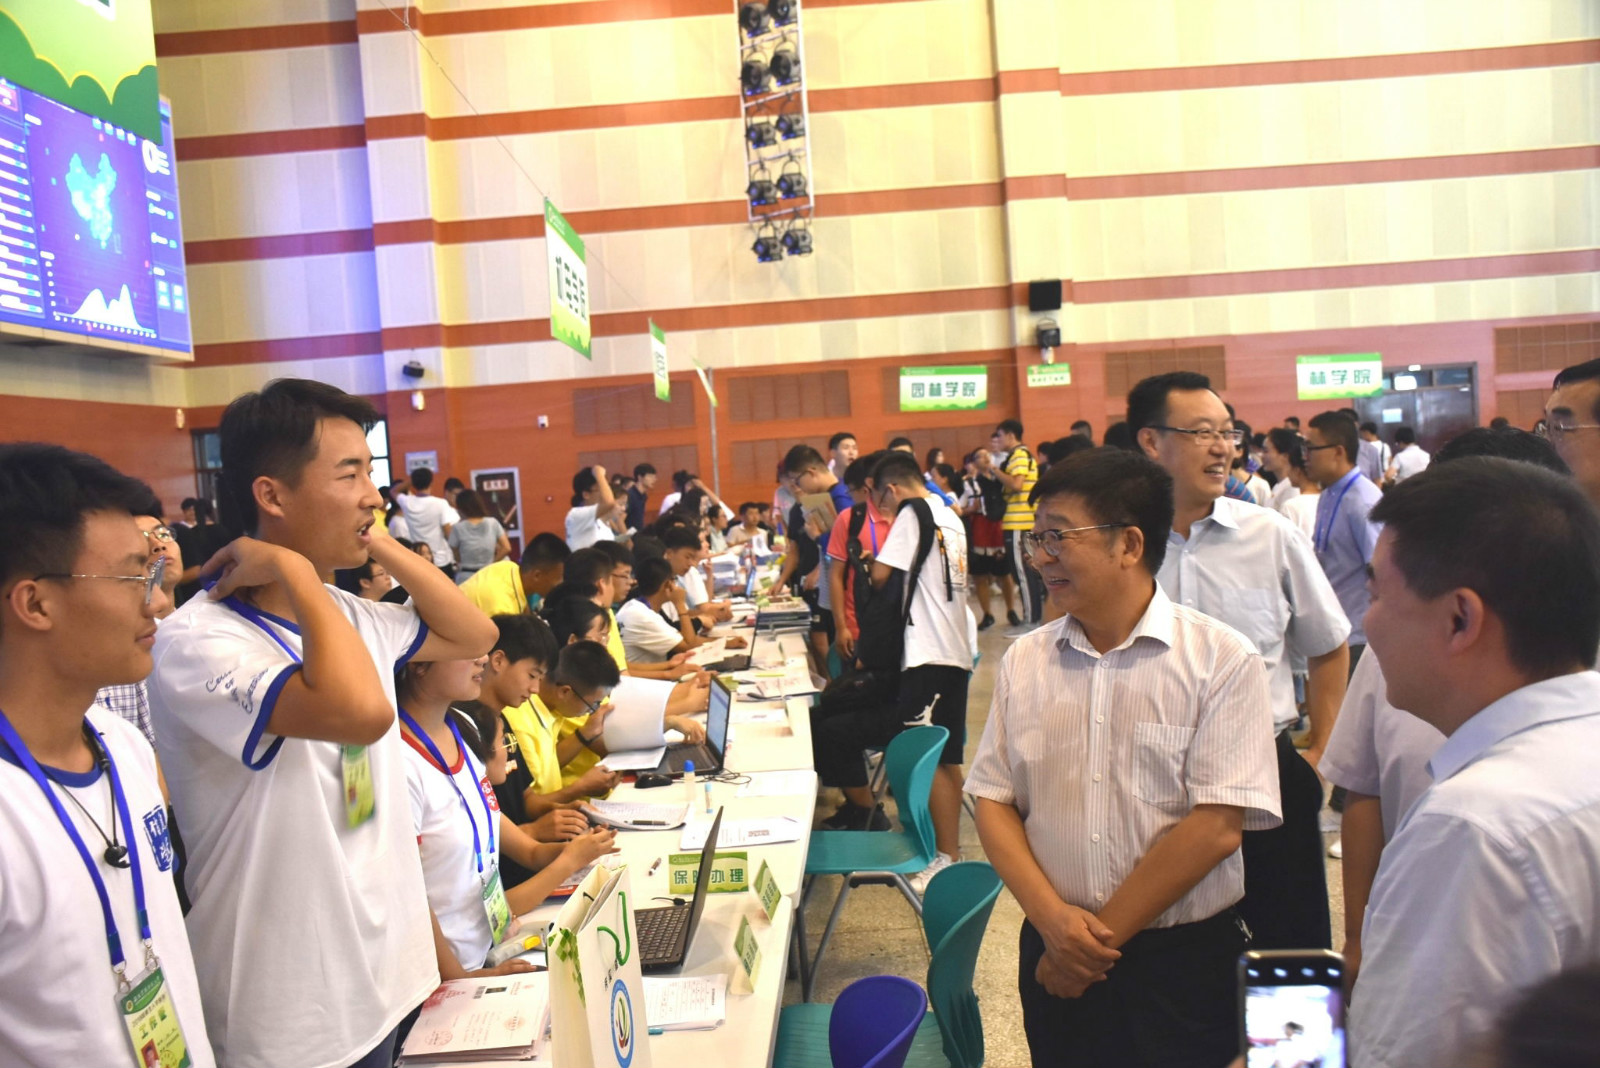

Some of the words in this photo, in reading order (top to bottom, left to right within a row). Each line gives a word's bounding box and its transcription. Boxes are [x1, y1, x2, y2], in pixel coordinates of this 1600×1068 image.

[1309, 369, 1371, 386] 林学院
[911, 381, 976, 398] 园林学院
